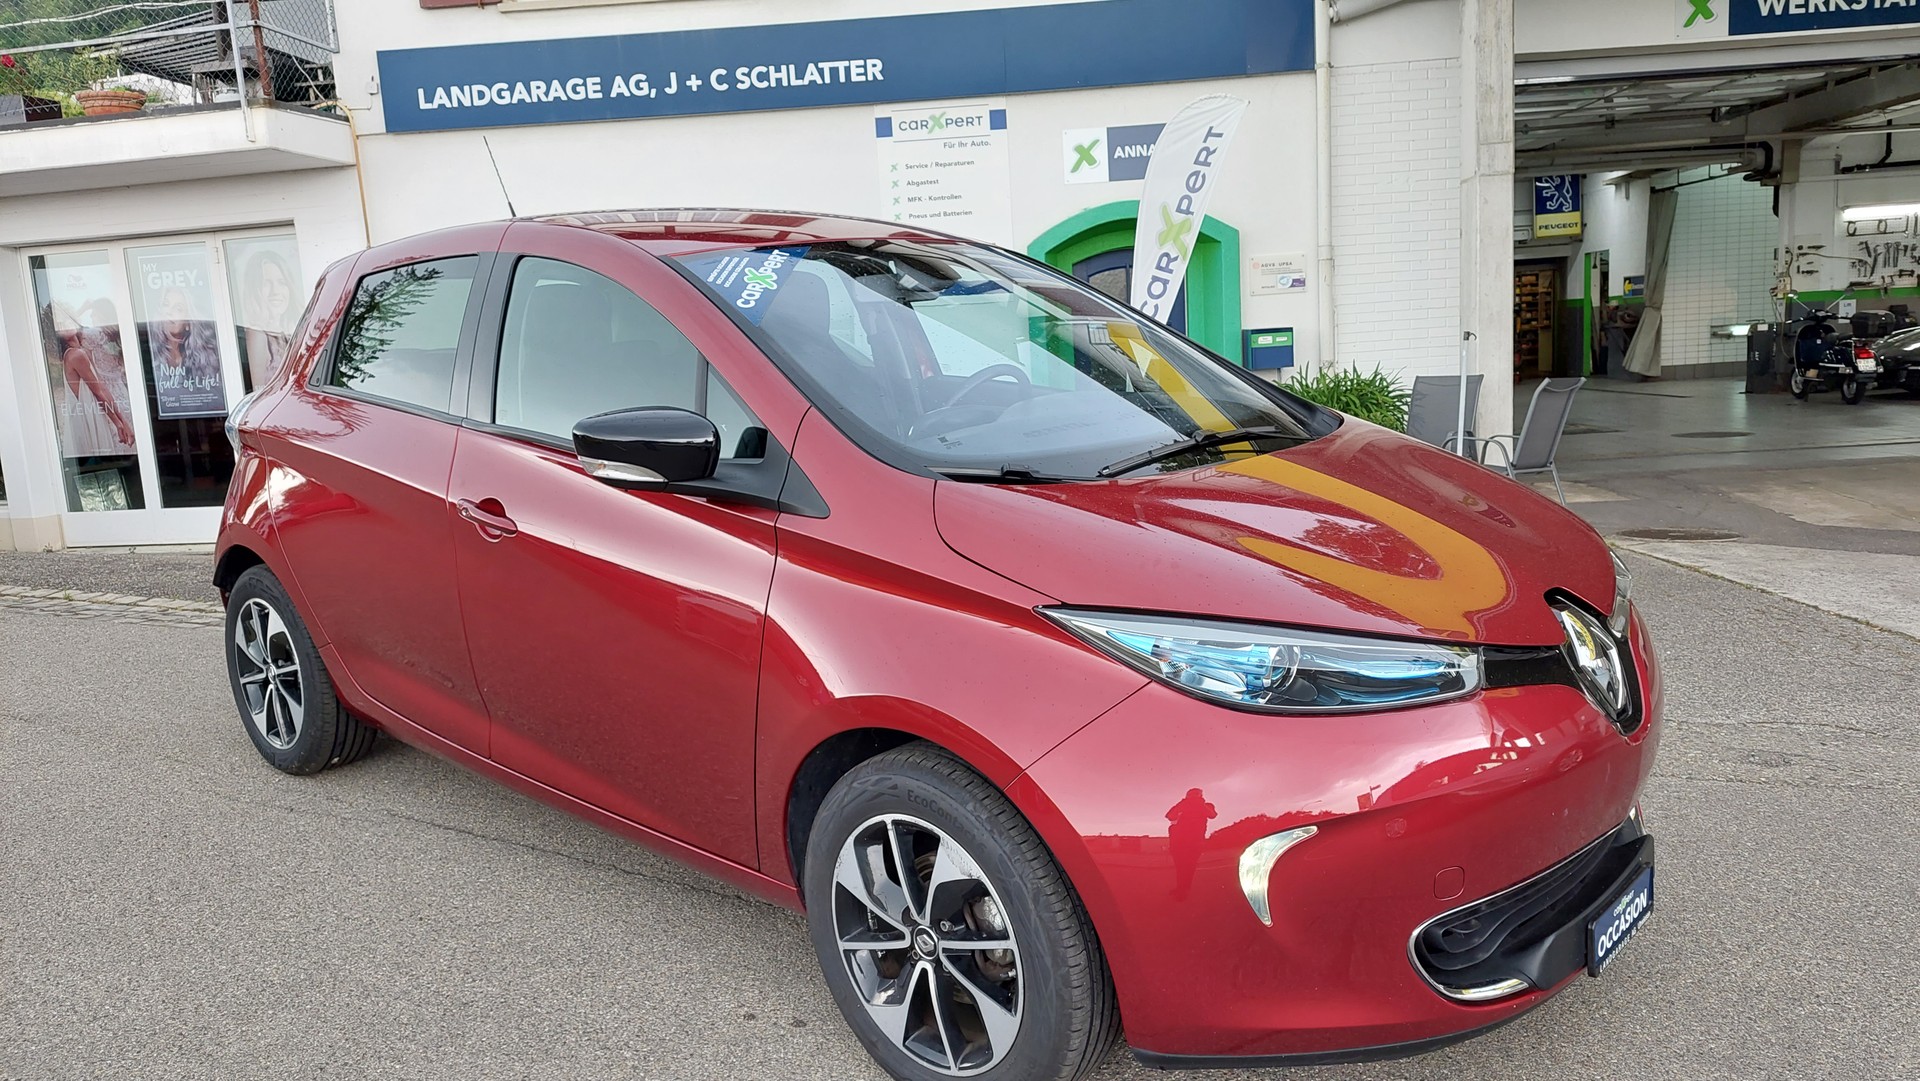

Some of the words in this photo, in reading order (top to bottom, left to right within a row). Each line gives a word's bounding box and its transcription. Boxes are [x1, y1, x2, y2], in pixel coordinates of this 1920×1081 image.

[417, 77, 603, 110] LANDGARAGE
[610, 73, 657, 99] AG,
[664, 72, 678, 95] J
[685, 74, 703, 92] +
[709, 68, 730, 92] C
[735, 58, 884, 90] SCHLATTER
[943, 141, 956, 149] Für
[958, 140, 968, 148] Ihr
[970, 140, 992, 148] Auto.
[905, 162, 928, 170] Service
[934, 160, 975, 169] Reparaturen
[906, 179, 939, 188] Abgastest
[928, 193, 962, 202] Kontrollen
[943, 209, 973, 217] Batterien
[1538, 221, 1579, 231] PEUGEOT
[142, 263, 157, 273] MY
[147, 269, 204, 290] GREY.
[160, 363, 186, 377] Now
[159, 374, 181, 394] full
[183, 375, 195, 392] of
[195, 373, 220, 391] Life!
[60, 401, 131, 416] ELEMENTS
[1597, 888, 1648, 958] OCCASION
